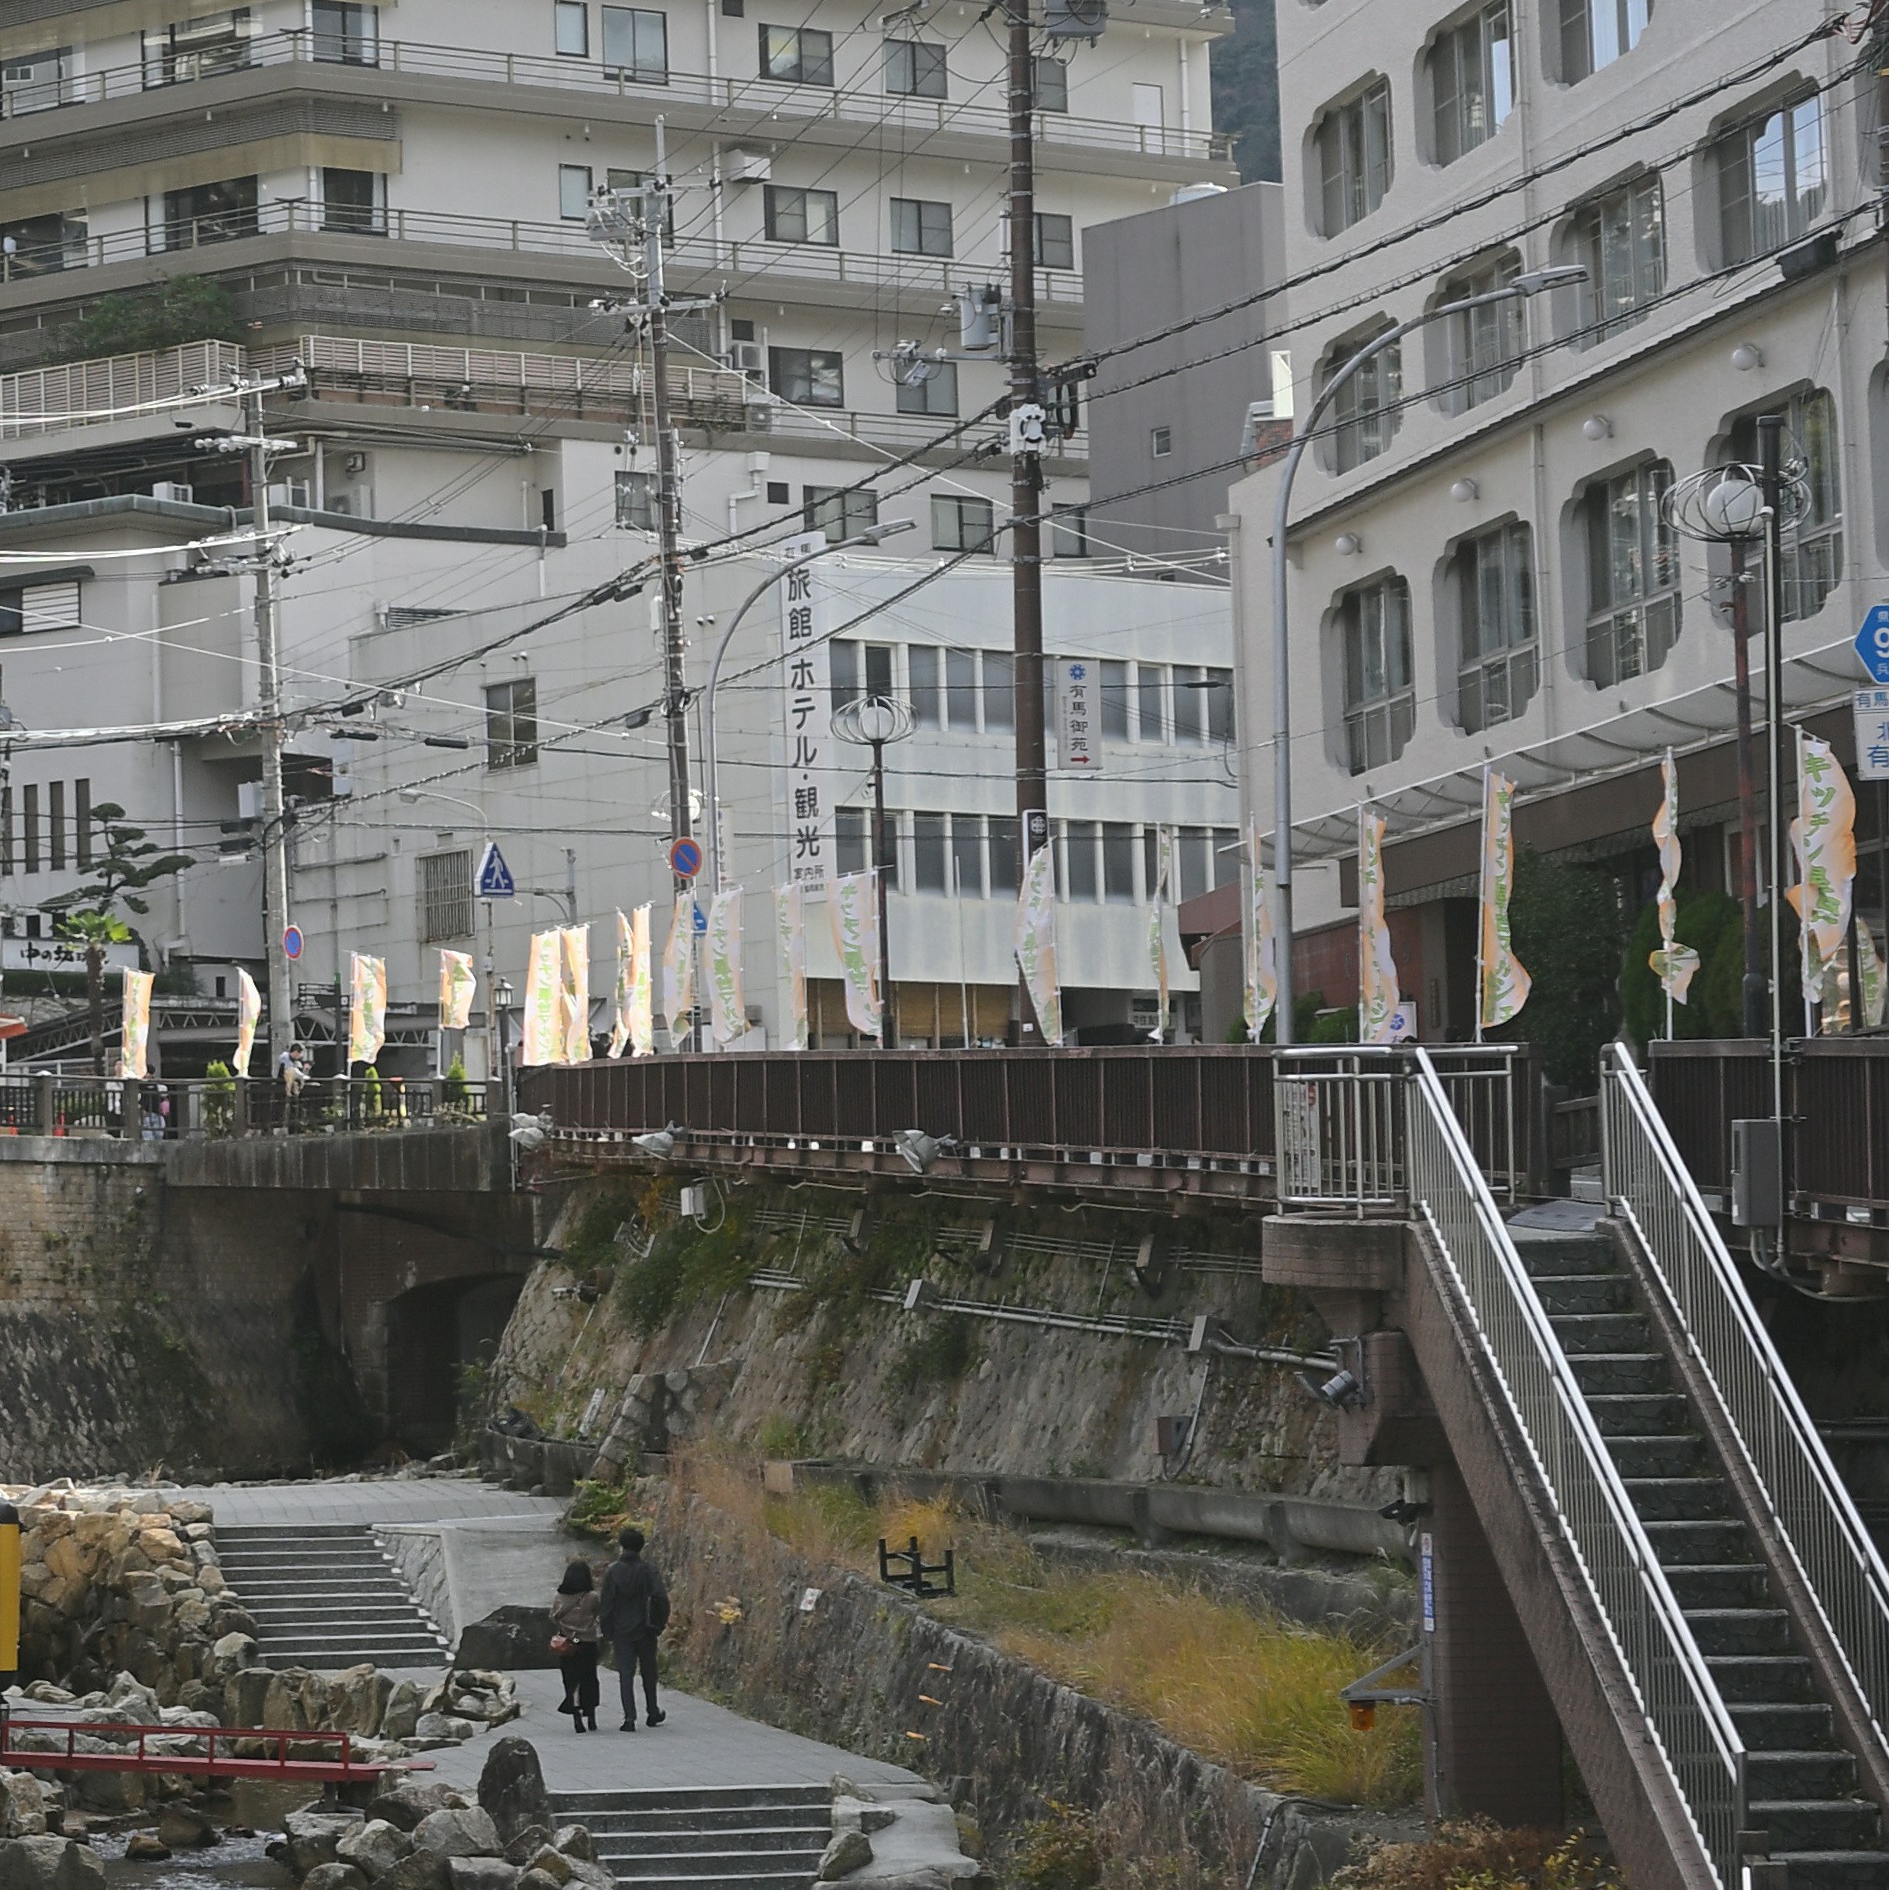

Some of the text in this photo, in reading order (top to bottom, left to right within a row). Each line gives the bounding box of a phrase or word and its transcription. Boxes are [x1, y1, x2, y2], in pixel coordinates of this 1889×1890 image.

[787, 568, 820, 859] 旅館ホテル・観光
[1069, 685, 1088, 752] 有馬御苑
[20, 941, 109, 969] 中の坊
